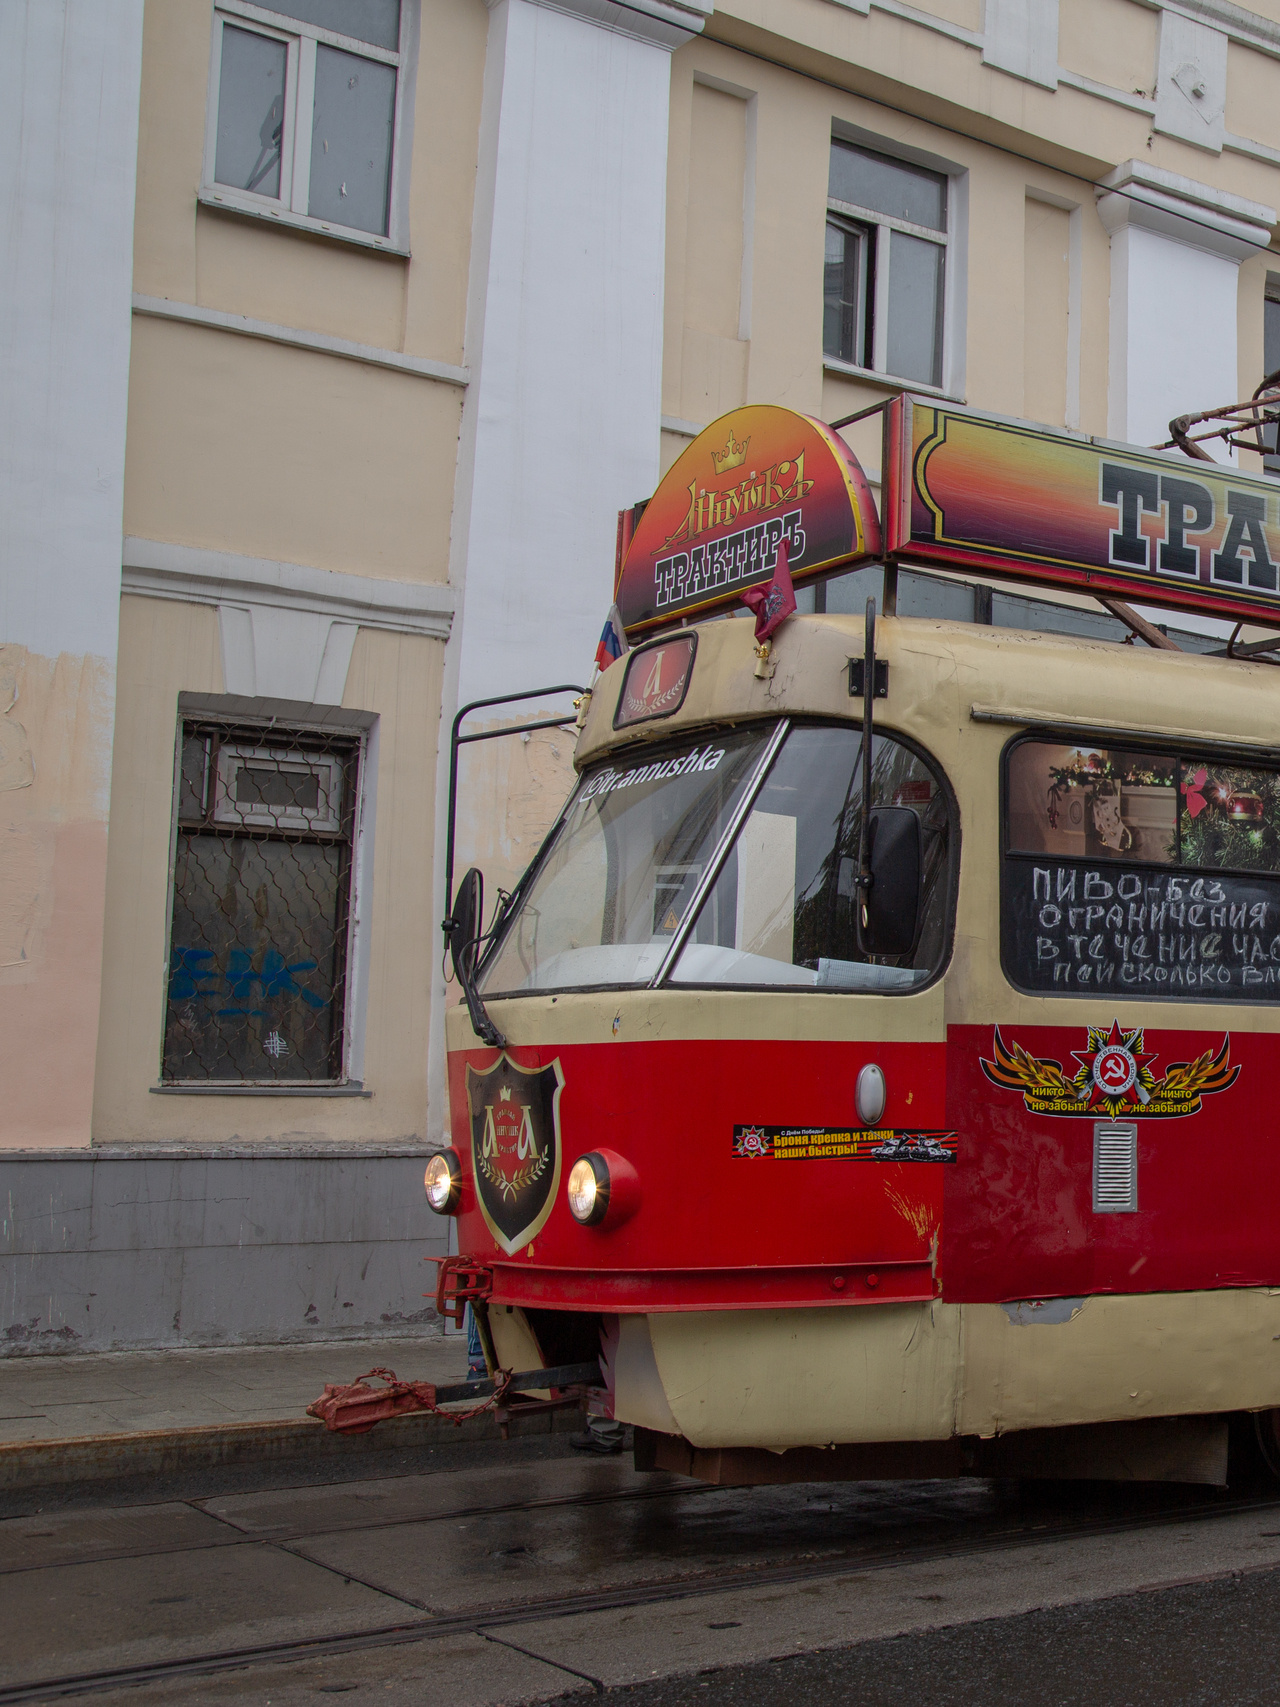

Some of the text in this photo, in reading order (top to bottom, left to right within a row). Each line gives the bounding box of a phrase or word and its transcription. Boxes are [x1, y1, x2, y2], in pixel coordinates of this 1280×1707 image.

[655, 509, 806, 607] ТРАКТИРЪ
[1032, 1101, 1047, 1112] не
[1133, 1104, 1148, 1114] не
[774, 1130, 895, 1148] Броня крепка и танки
[774, 1143, 858, 1159] наши быстры!
